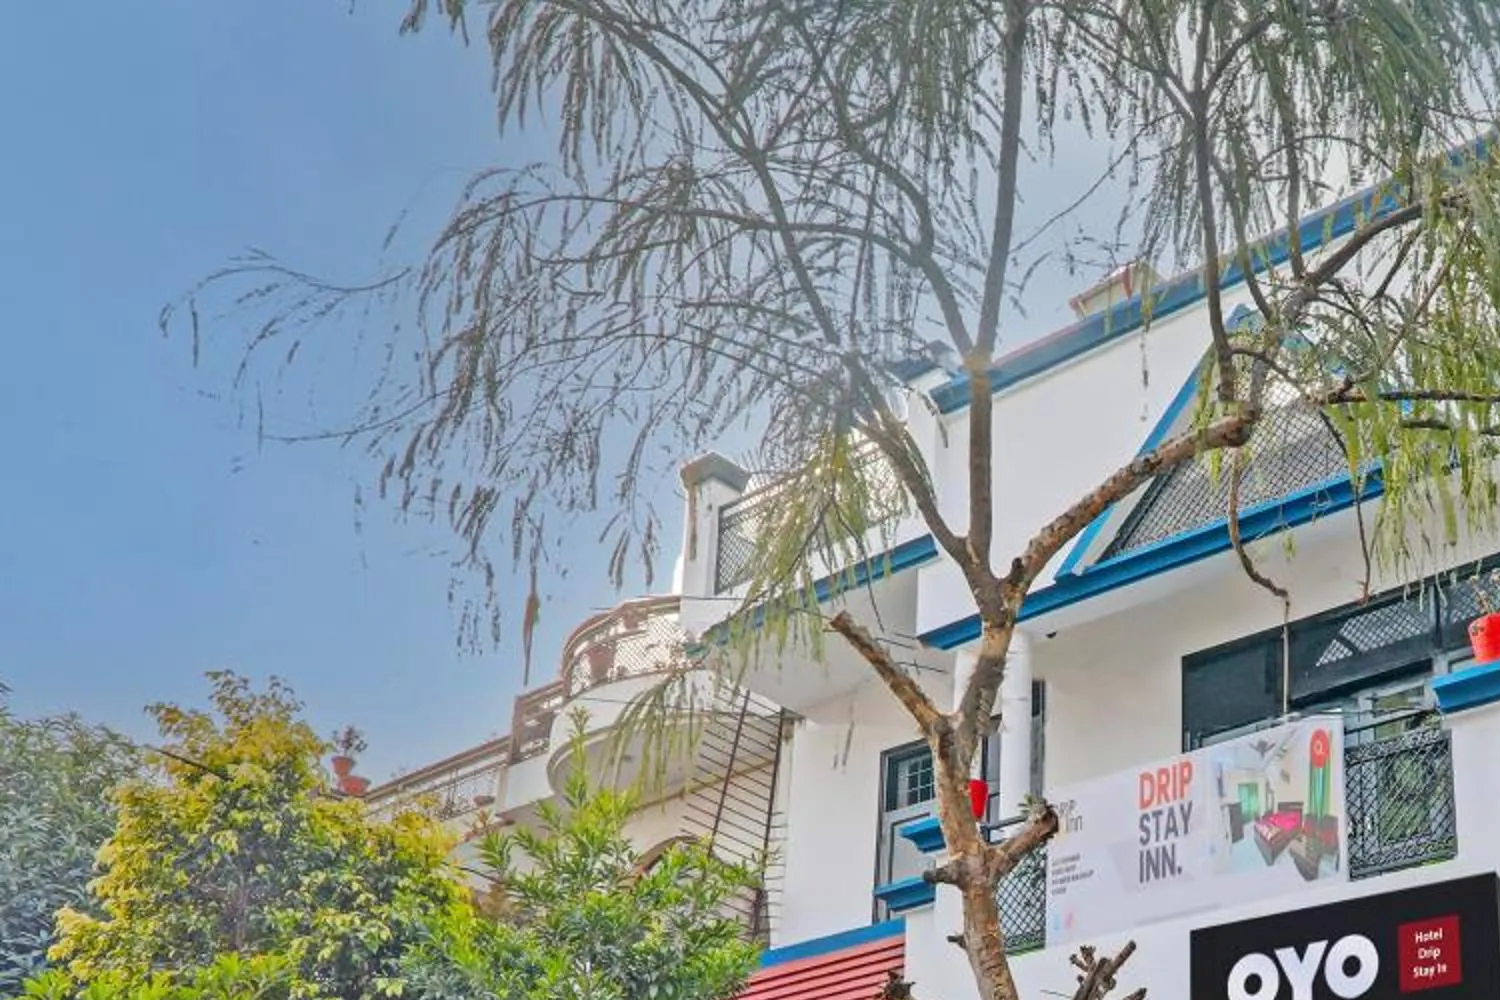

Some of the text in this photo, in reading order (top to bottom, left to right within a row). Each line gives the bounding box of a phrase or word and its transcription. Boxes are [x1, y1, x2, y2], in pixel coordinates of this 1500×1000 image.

[1138, 760, 1193, 810] DRIP
[1138, 799, 1193, 846] STAY
[1138, 843, 1182, 884] INN.
[1414, 927, 1443, 944] Hotel
[1417, 945, 1441, 960] Drip
[1412, 965, 1435, 980] Stay
